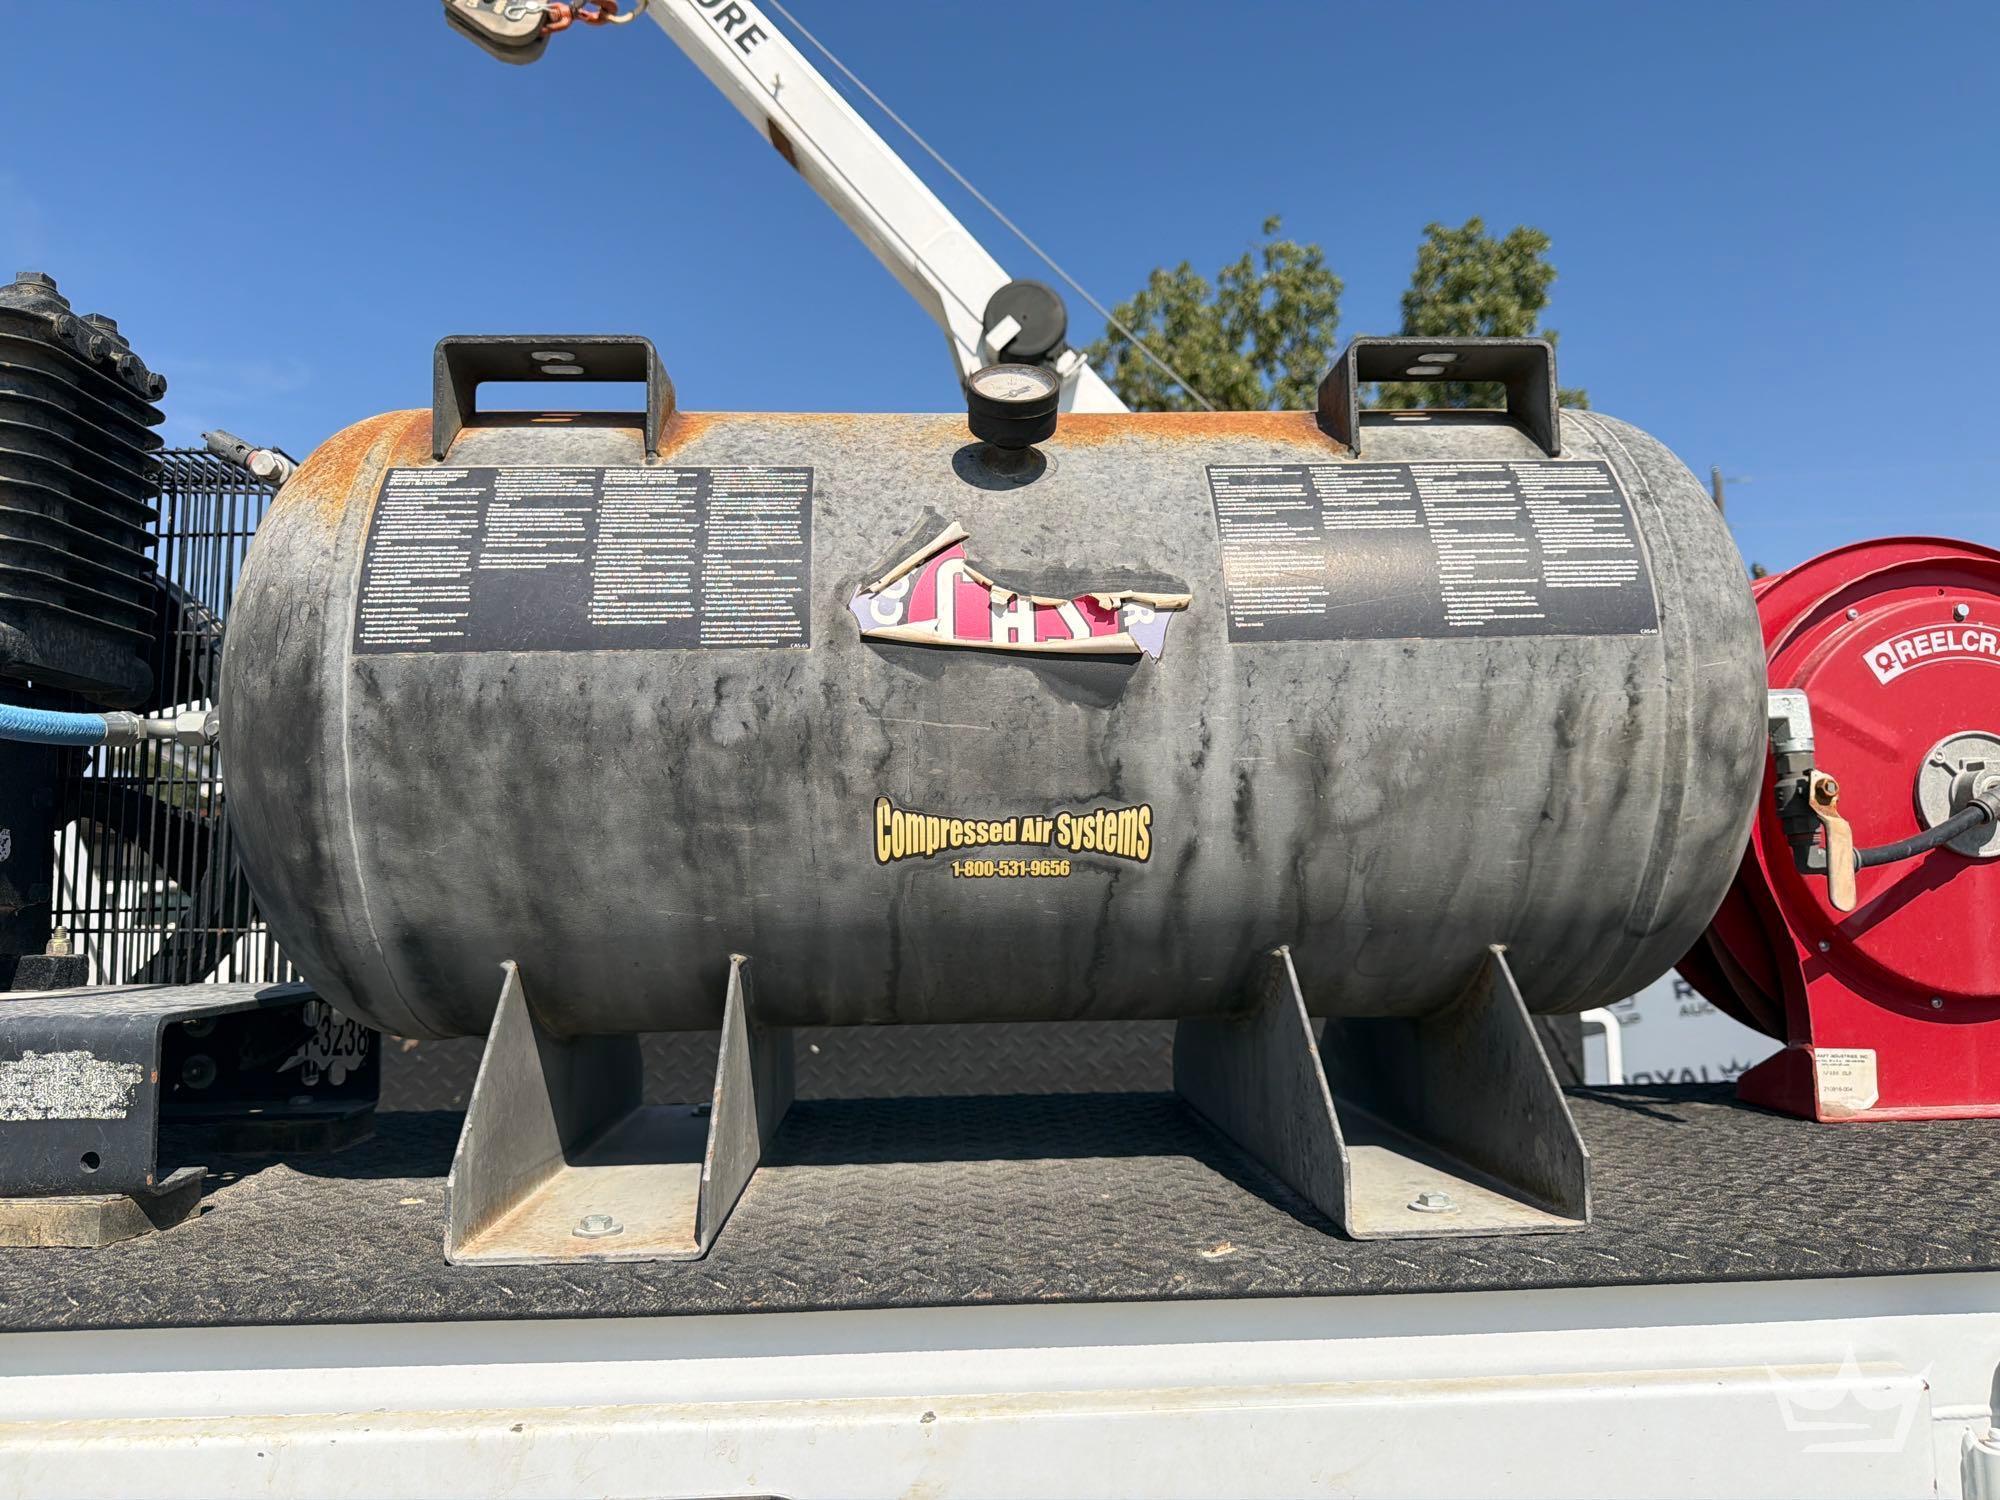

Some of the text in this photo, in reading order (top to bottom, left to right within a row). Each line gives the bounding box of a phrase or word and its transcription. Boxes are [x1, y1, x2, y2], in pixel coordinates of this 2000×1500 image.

[1894, 629, 2000, 664] REELCR
[875, 796, 1151, 863] Compressed Air Systems
[951, 859, 1071, 877] 1-800-531-9656
[1622, 1065, 1709, 1085] OYAL
